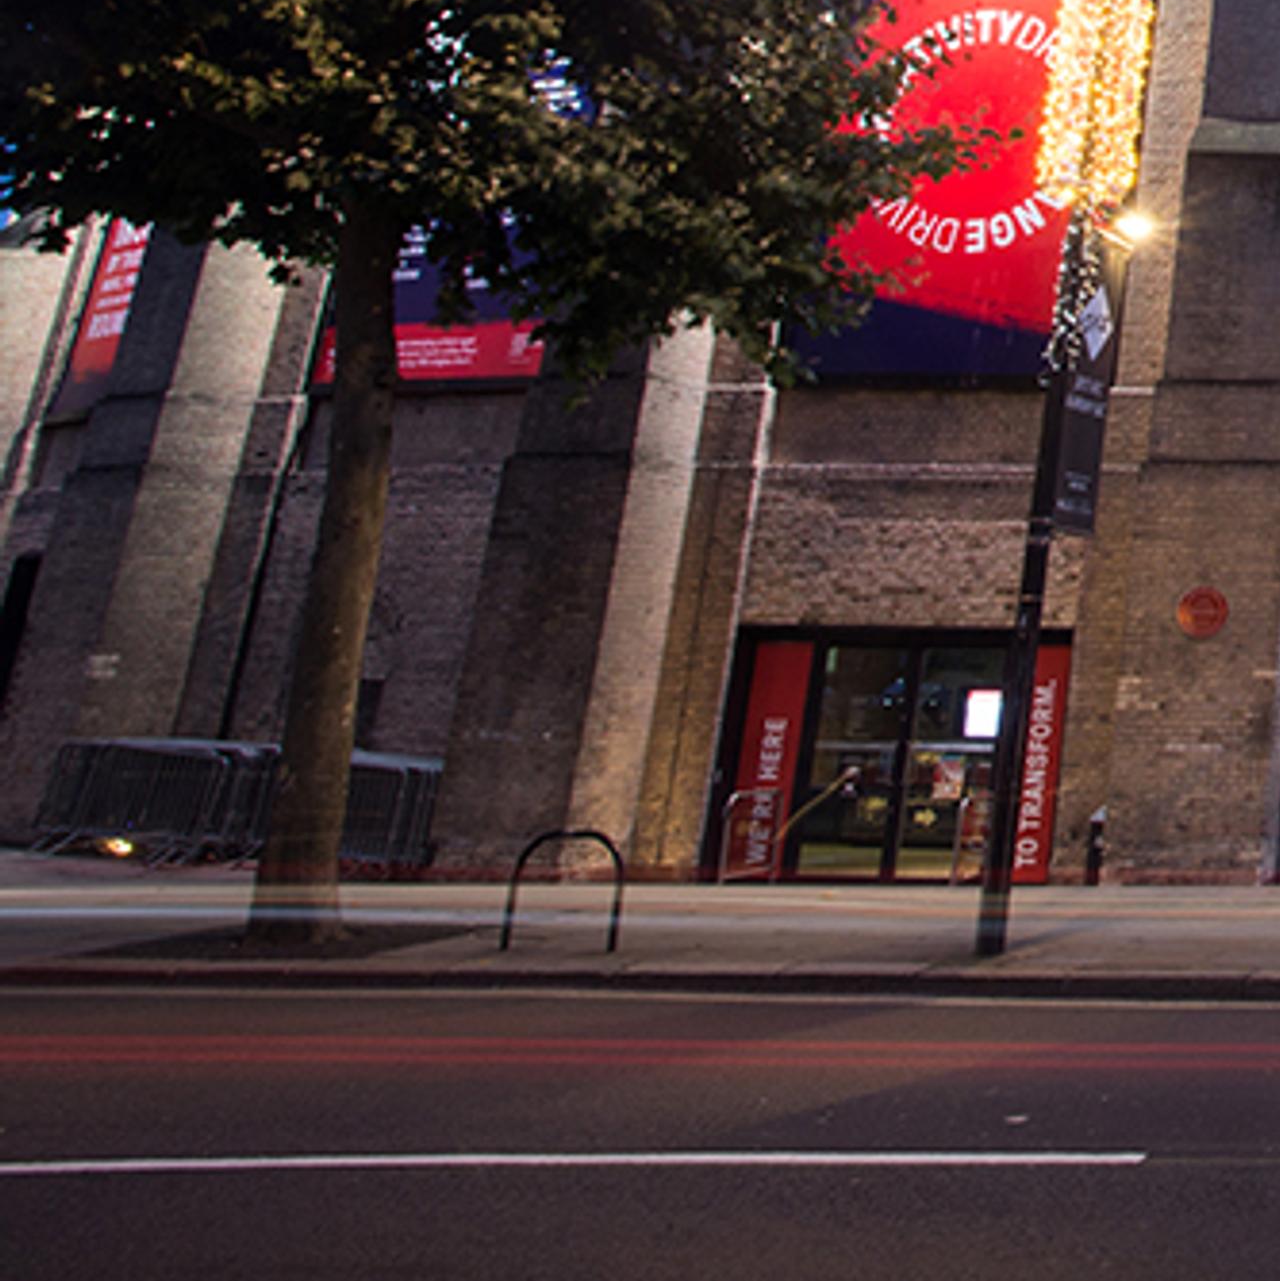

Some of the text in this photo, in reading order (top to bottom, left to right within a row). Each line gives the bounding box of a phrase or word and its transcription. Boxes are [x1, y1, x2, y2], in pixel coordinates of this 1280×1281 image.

[870, 193, 962, 255] DRIV
[756, 716, 789, 781] HERE
[1013, 678, 1058, 869] TO TRANSFORM.
